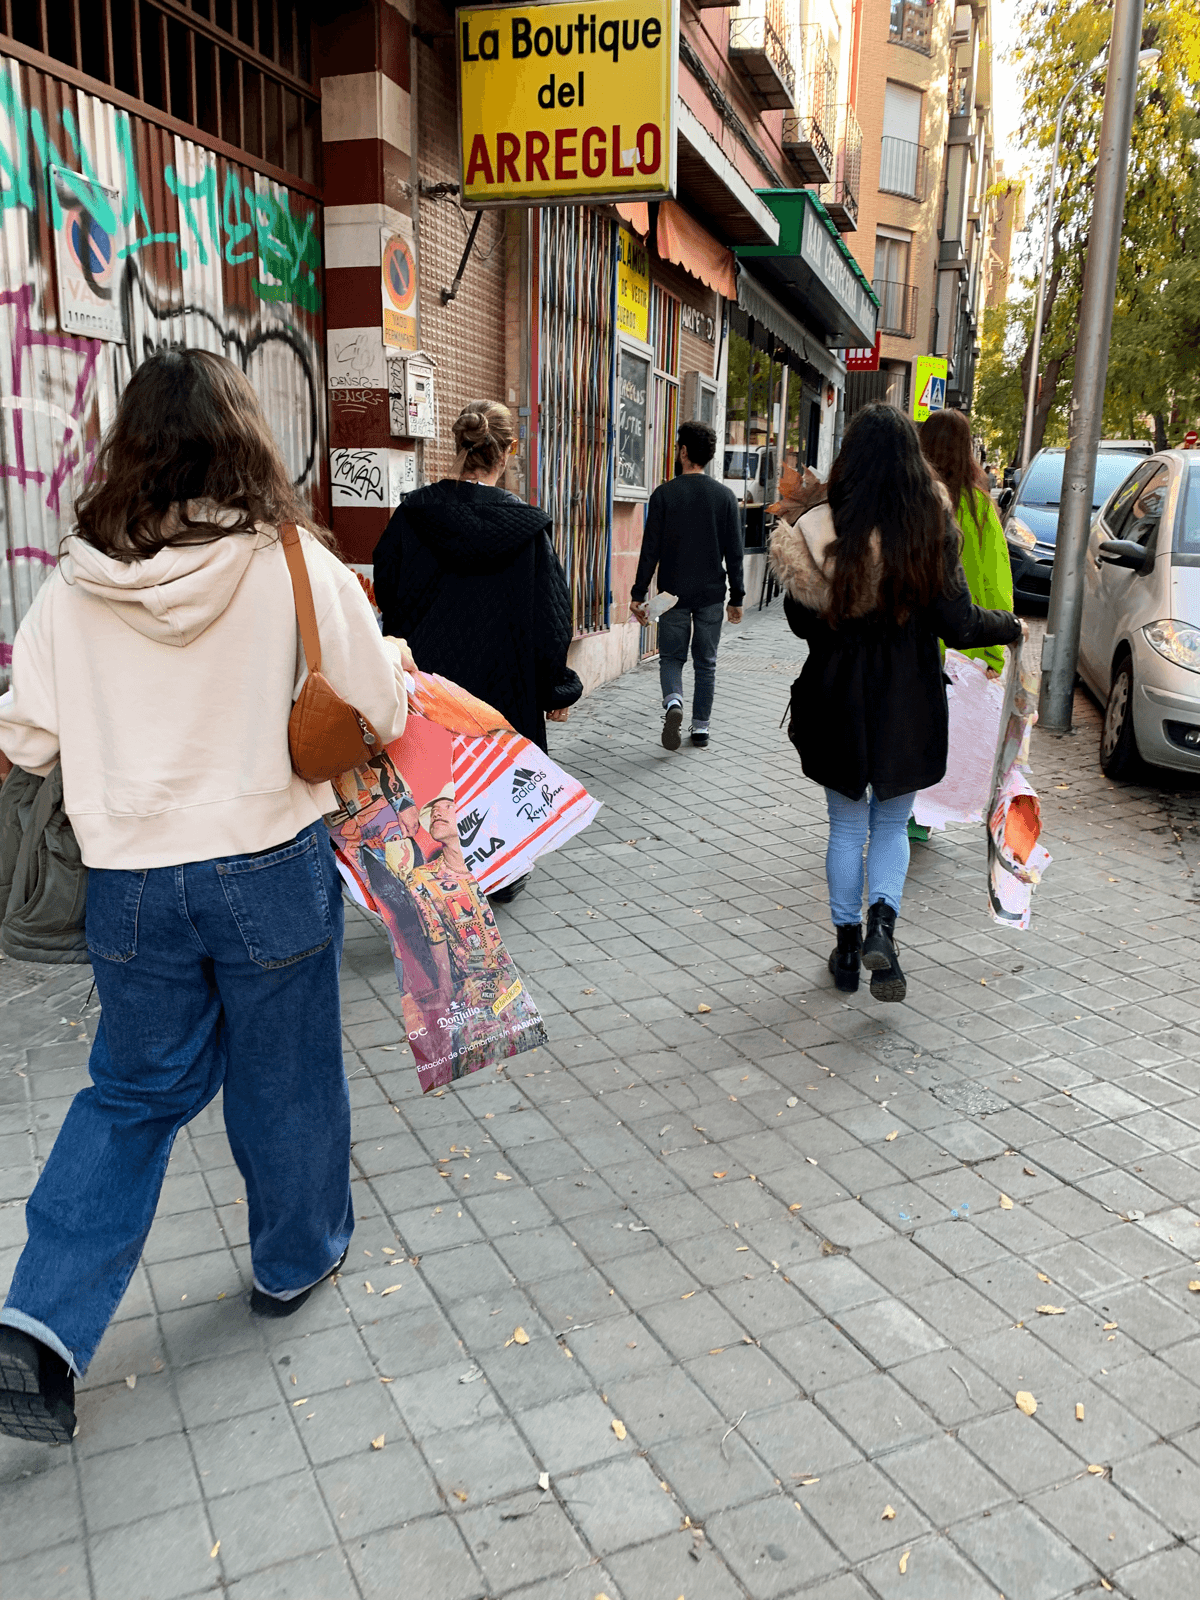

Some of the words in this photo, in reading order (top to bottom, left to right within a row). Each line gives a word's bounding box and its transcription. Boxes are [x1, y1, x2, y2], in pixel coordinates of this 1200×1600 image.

[463, 22, 499, 62] La
[512, 14, 661, 62] Boutique
[538, 71, 584, 109] del
[466, 123, 661, 185] ARREGLO
[806, 212, 822, 268] BAR
[512, 770, 547, 804] adidas
[457, 808, 483, 836] NIKE
[464, 837, 506, 872] FILA
[447, 1051, 458, 1060] de
